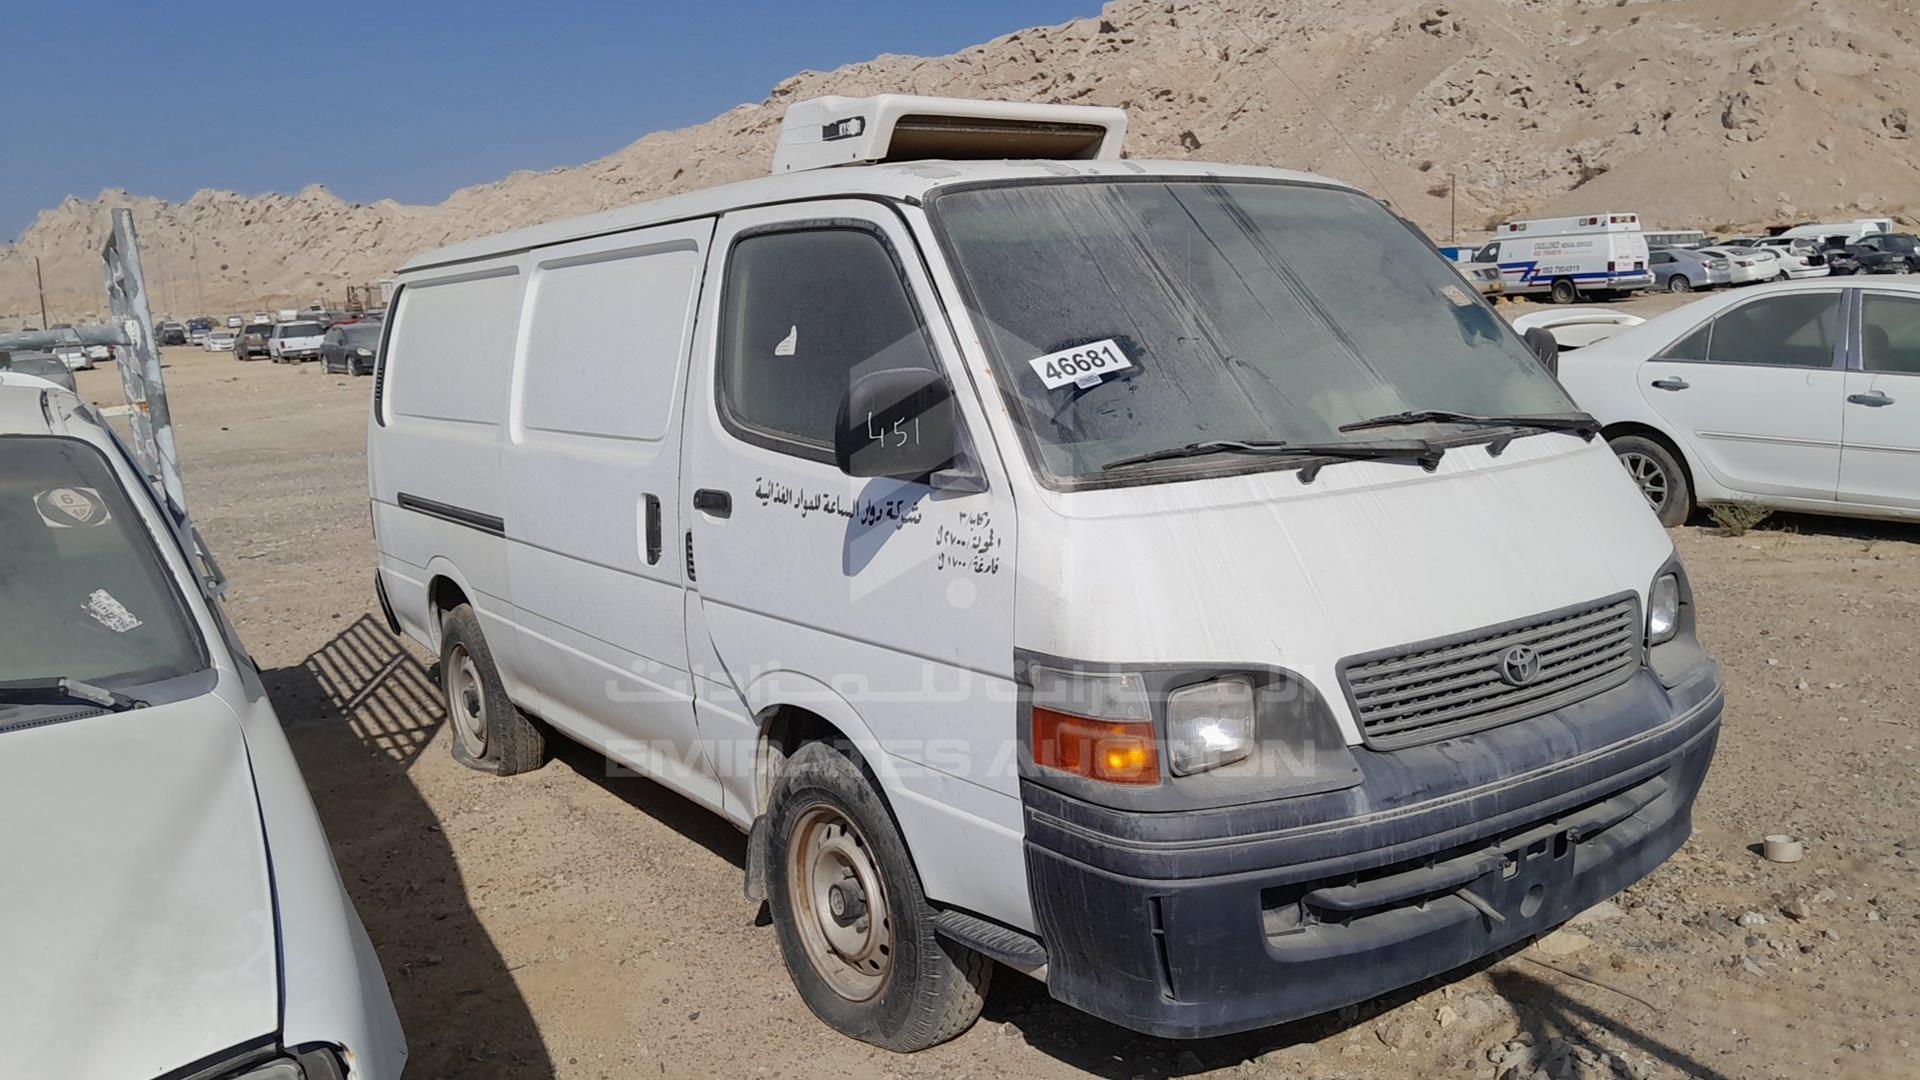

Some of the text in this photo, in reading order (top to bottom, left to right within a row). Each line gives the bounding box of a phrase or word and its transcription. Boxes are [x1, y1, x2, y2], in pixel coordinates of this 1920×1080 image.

[1045, 346, 1119, 379] 46681
[867, 411, 920, 448] 451
[755, 477, 793, 506] الغذائية
[794, 487, 821, 518] للمواد
[823, 493, 860, 519] الساعة
[885, 499, 922, 531] شركة
